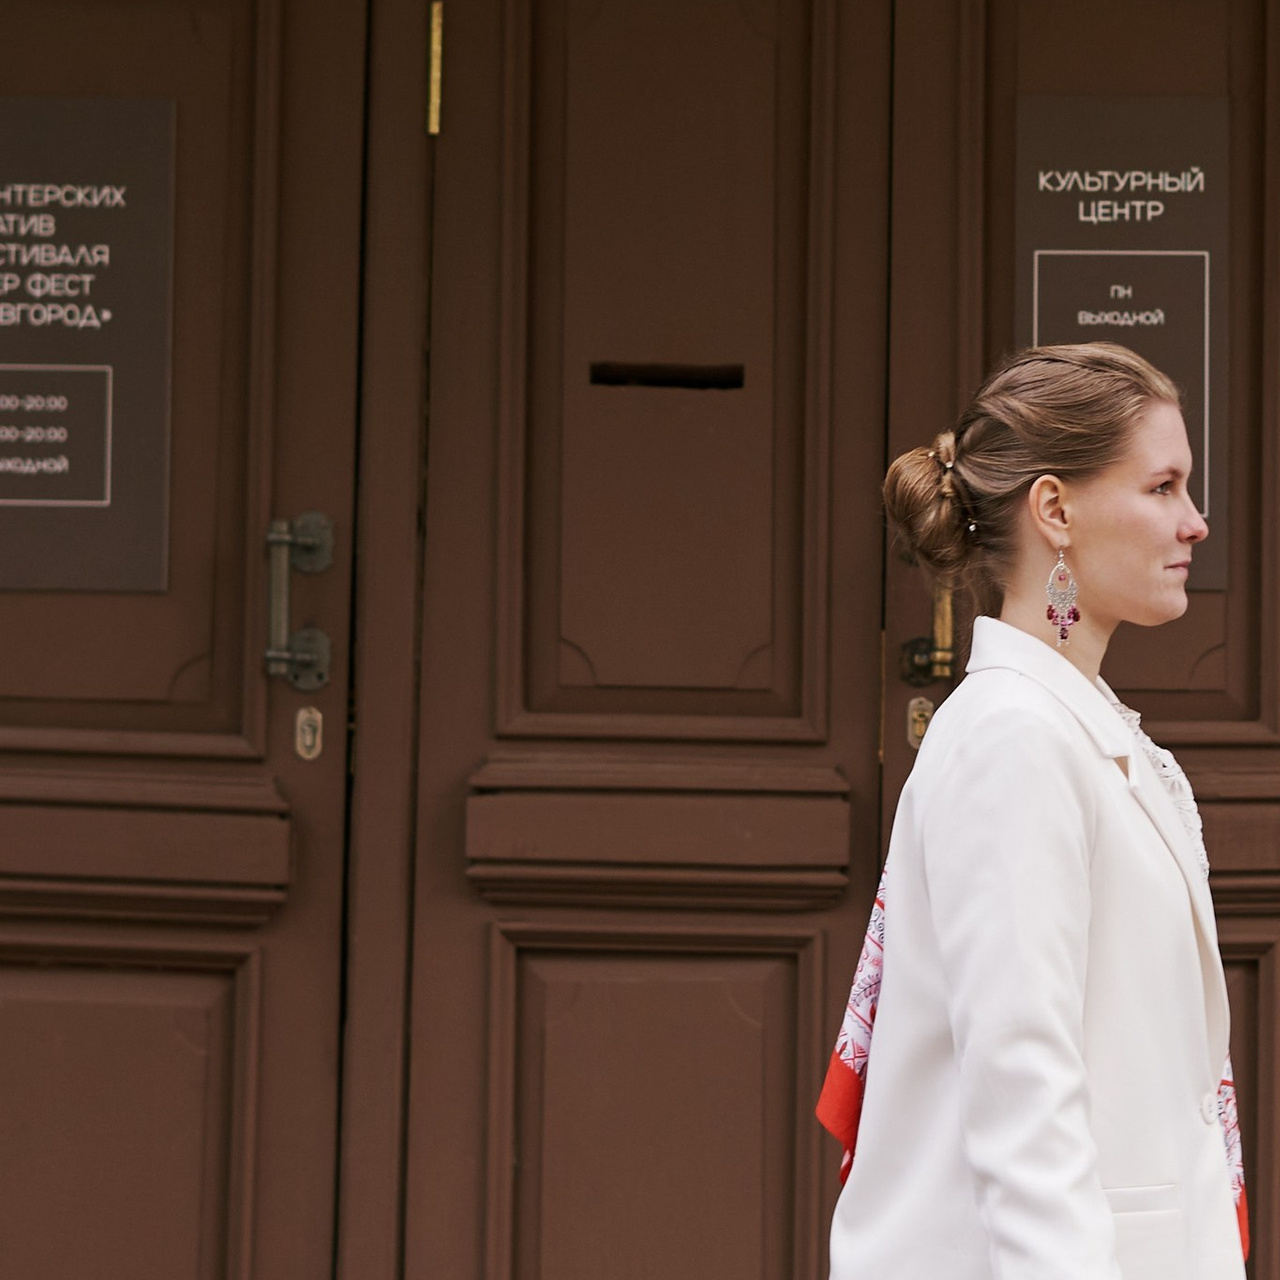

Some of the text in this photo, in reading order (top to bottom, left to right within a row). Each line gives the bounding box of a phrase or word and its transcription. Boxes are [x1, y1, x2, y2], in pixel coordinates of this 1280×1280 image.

[1038, 167, 1205, 192] КУЛЬТУРНЫЙ
[1078, 201, 1165, 224] ЦЕНТР
[26, 273, 96, 298] ФЕСТ
[1110, 285, 1132, 299] ПН
[1078, 308, 1165, 326] ВЫХОДНОЙ
